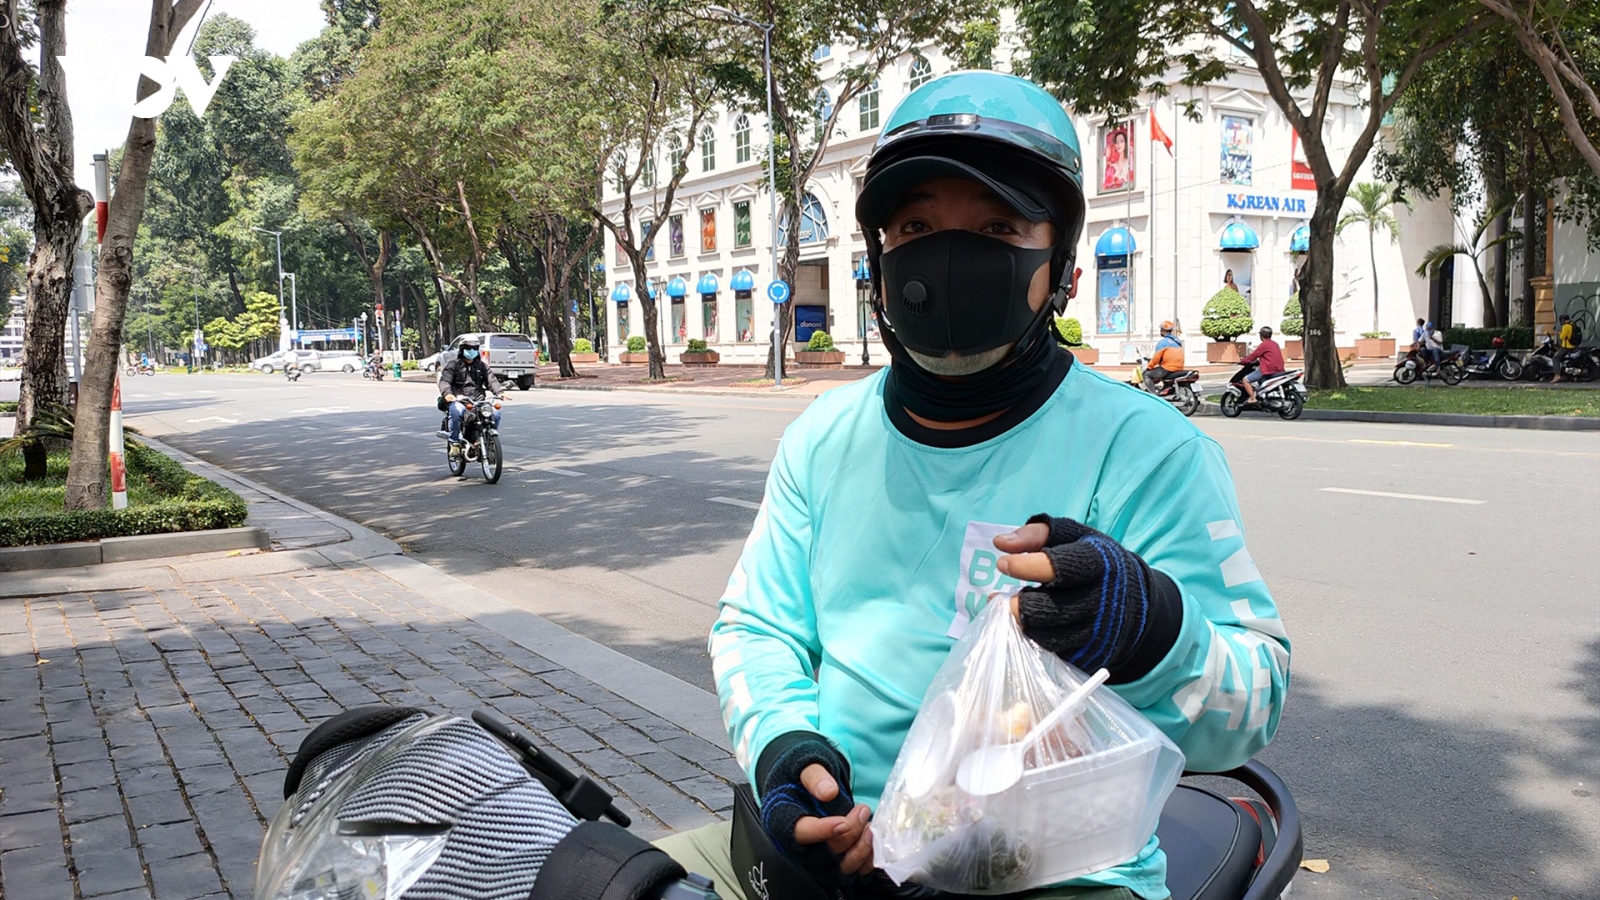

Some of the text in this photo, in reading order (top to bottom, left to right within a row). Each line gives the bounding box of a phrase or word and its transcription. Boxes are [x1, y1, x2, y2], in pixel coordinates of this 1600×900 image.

[1293, 172, 1315, 181] LOTTER
[1227, 193, 1306, 213] KOREAN AIR
[800, 320, 823, 328] diamond
